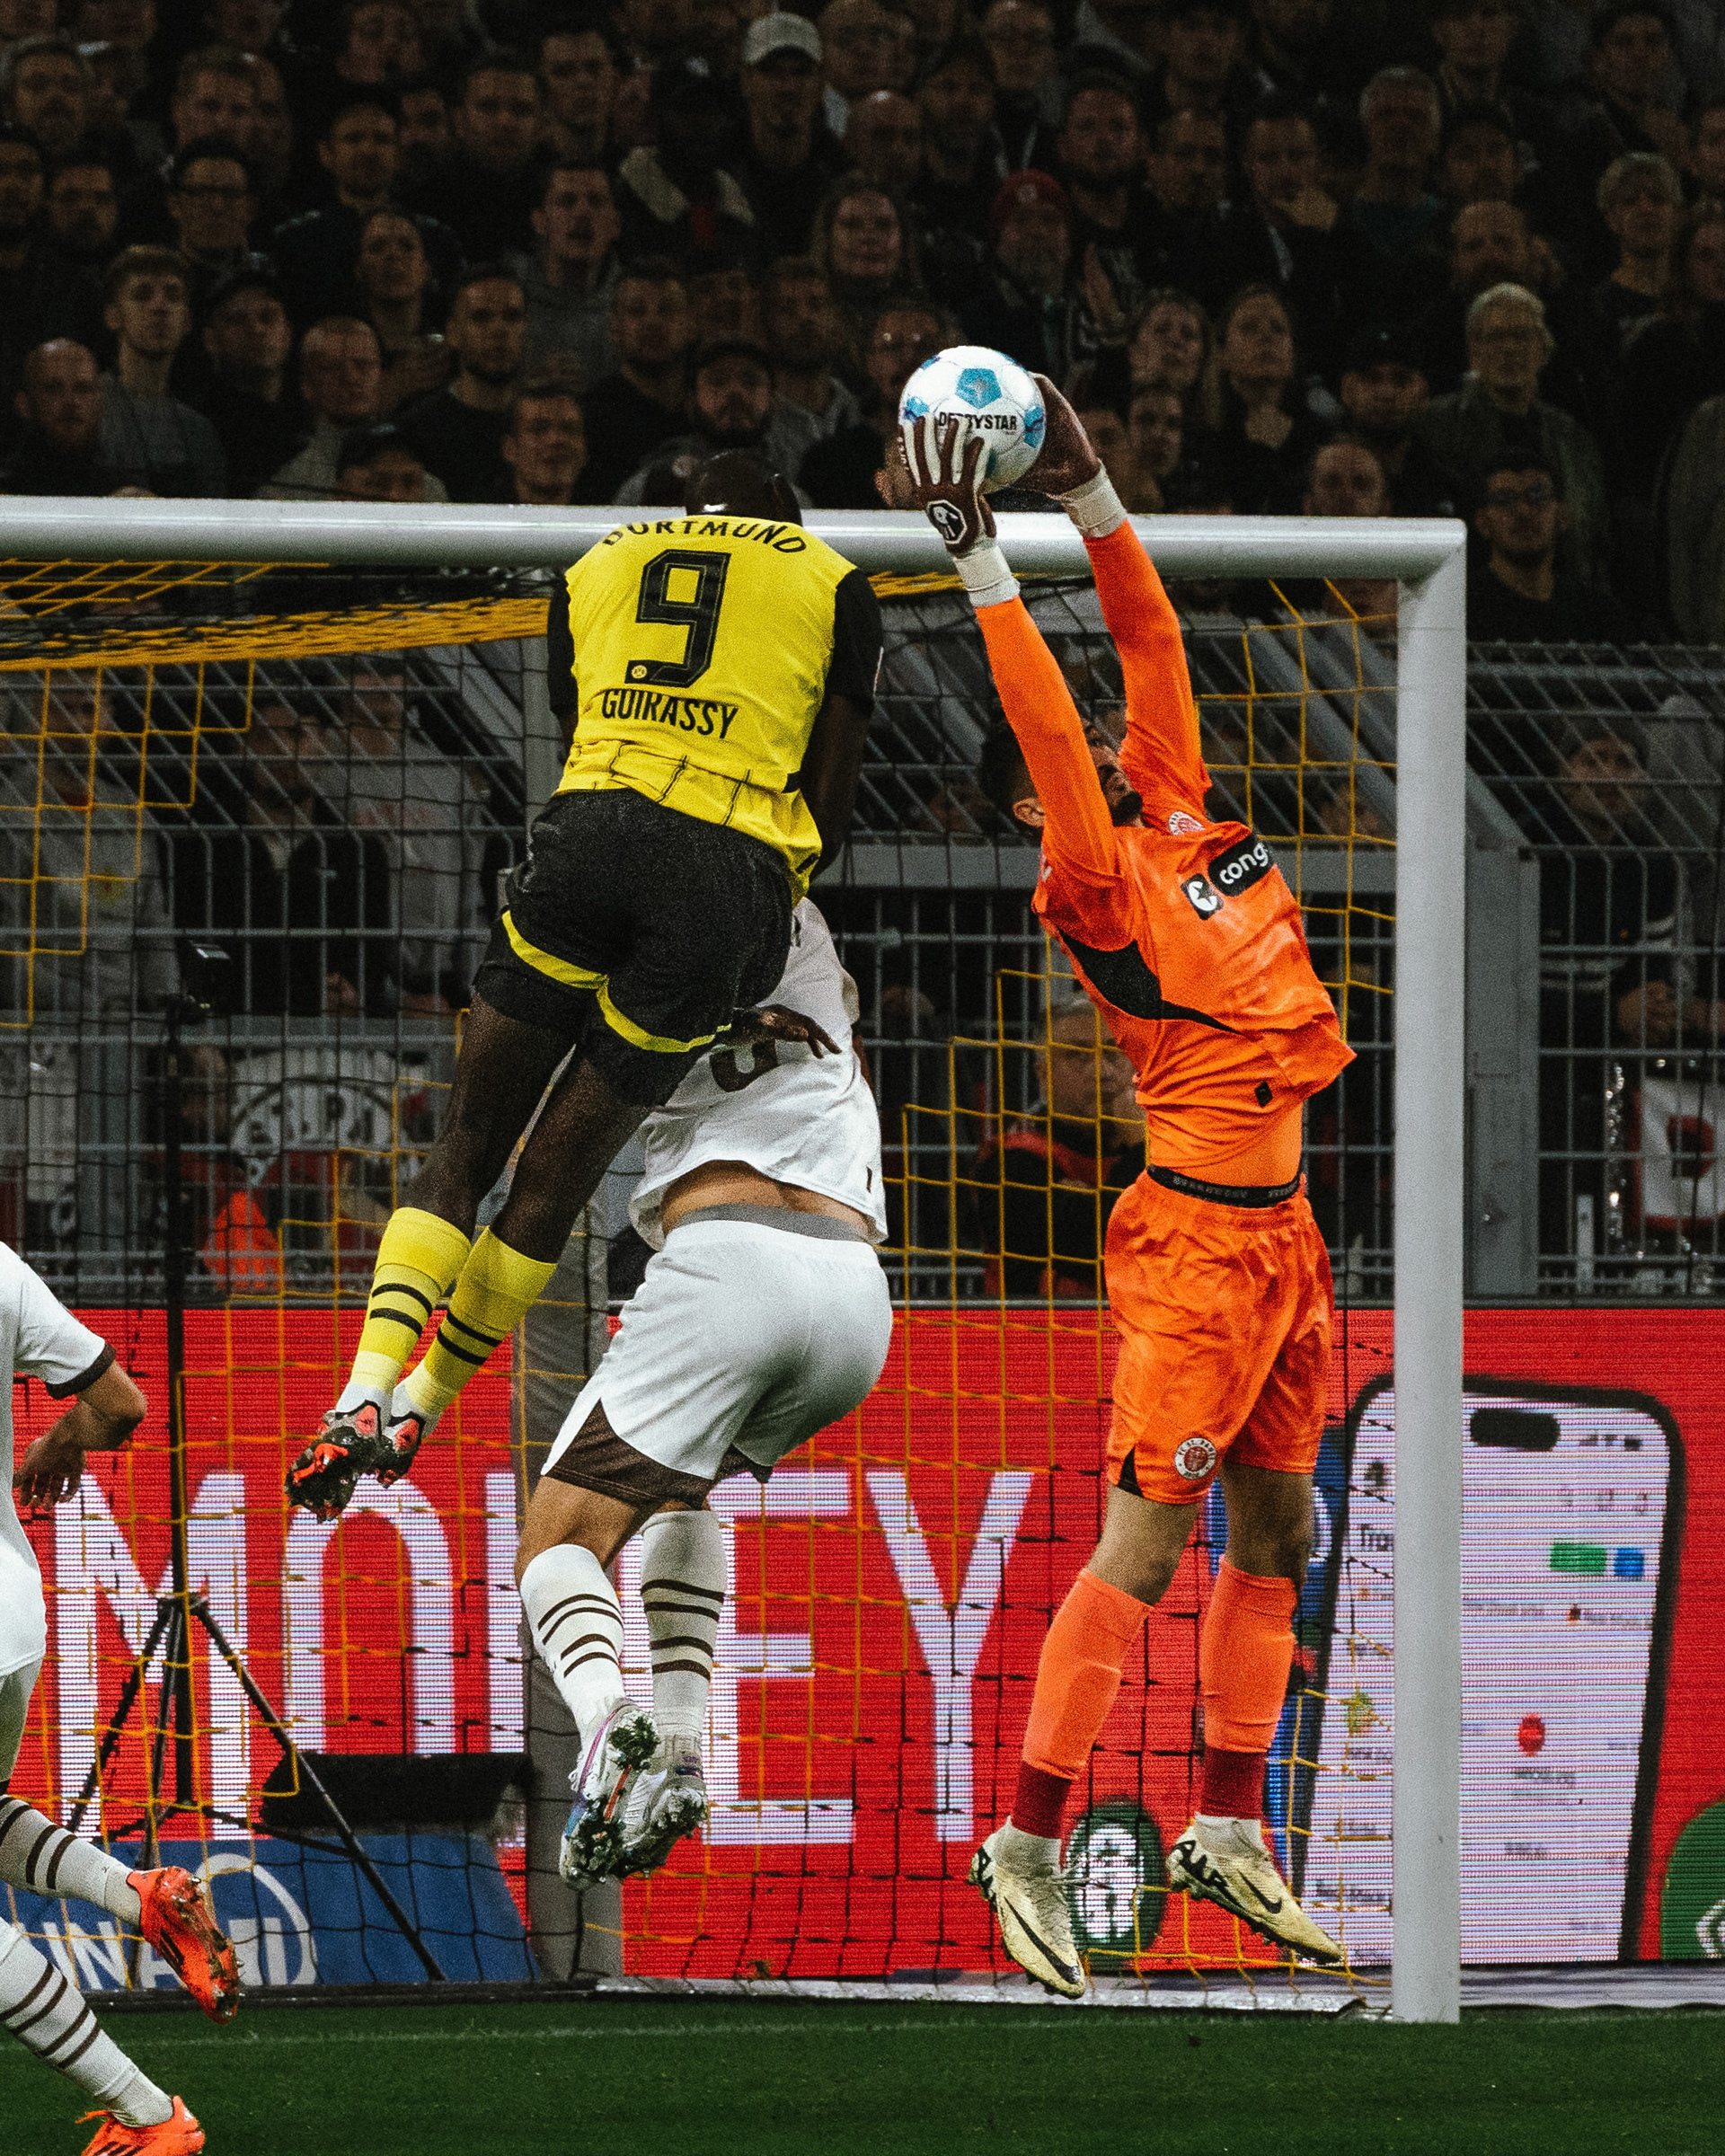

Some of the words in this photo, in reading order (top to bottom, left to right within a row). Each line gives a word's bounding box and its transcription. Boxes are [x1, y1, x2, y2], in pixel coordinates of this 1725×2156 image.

[602, 520, 807, 553] DORTMUND
[624, 549, 731, 688] 9
[601, 689, 739, 739] GUIRASSY
